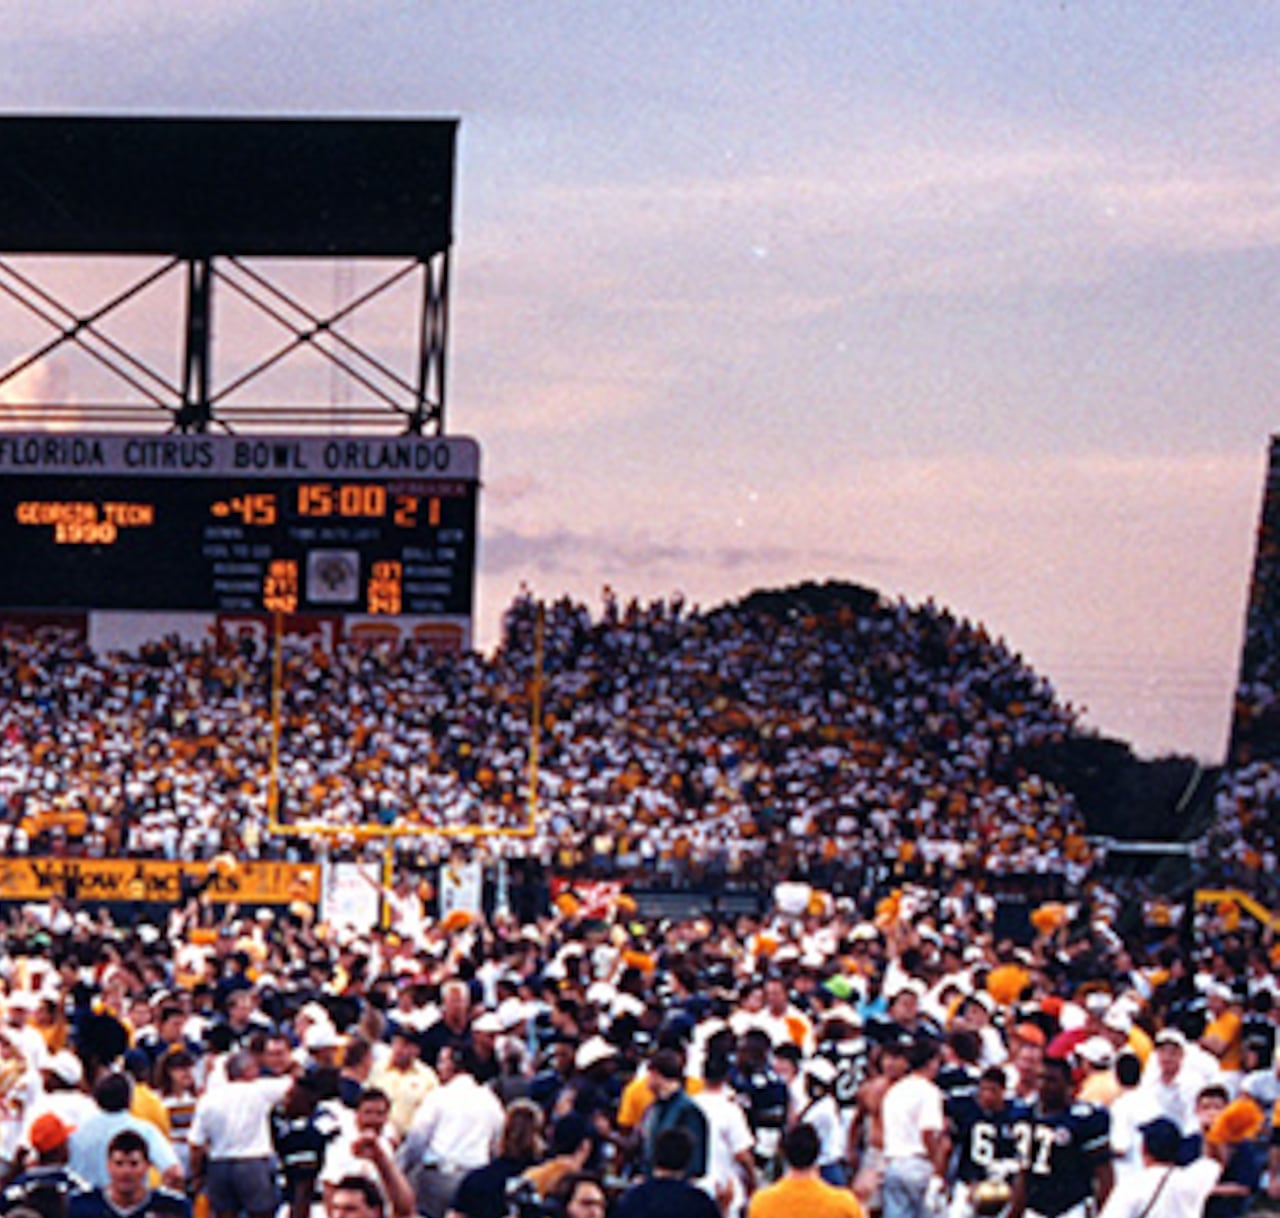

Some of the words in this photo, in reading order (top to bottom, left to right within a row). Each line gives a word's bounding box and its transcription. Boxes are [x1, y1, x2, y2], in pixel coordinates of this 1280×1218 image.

[124, 439, 214, 468] CITRUS
[234, 440, 308, 469] BOWL
[322, 441, 451, 470] ORLANDO
[298, 483, 387, 517] 15:00
[102, 502, 156, 526] TECH
[55, 522, 118, 545] 1990
